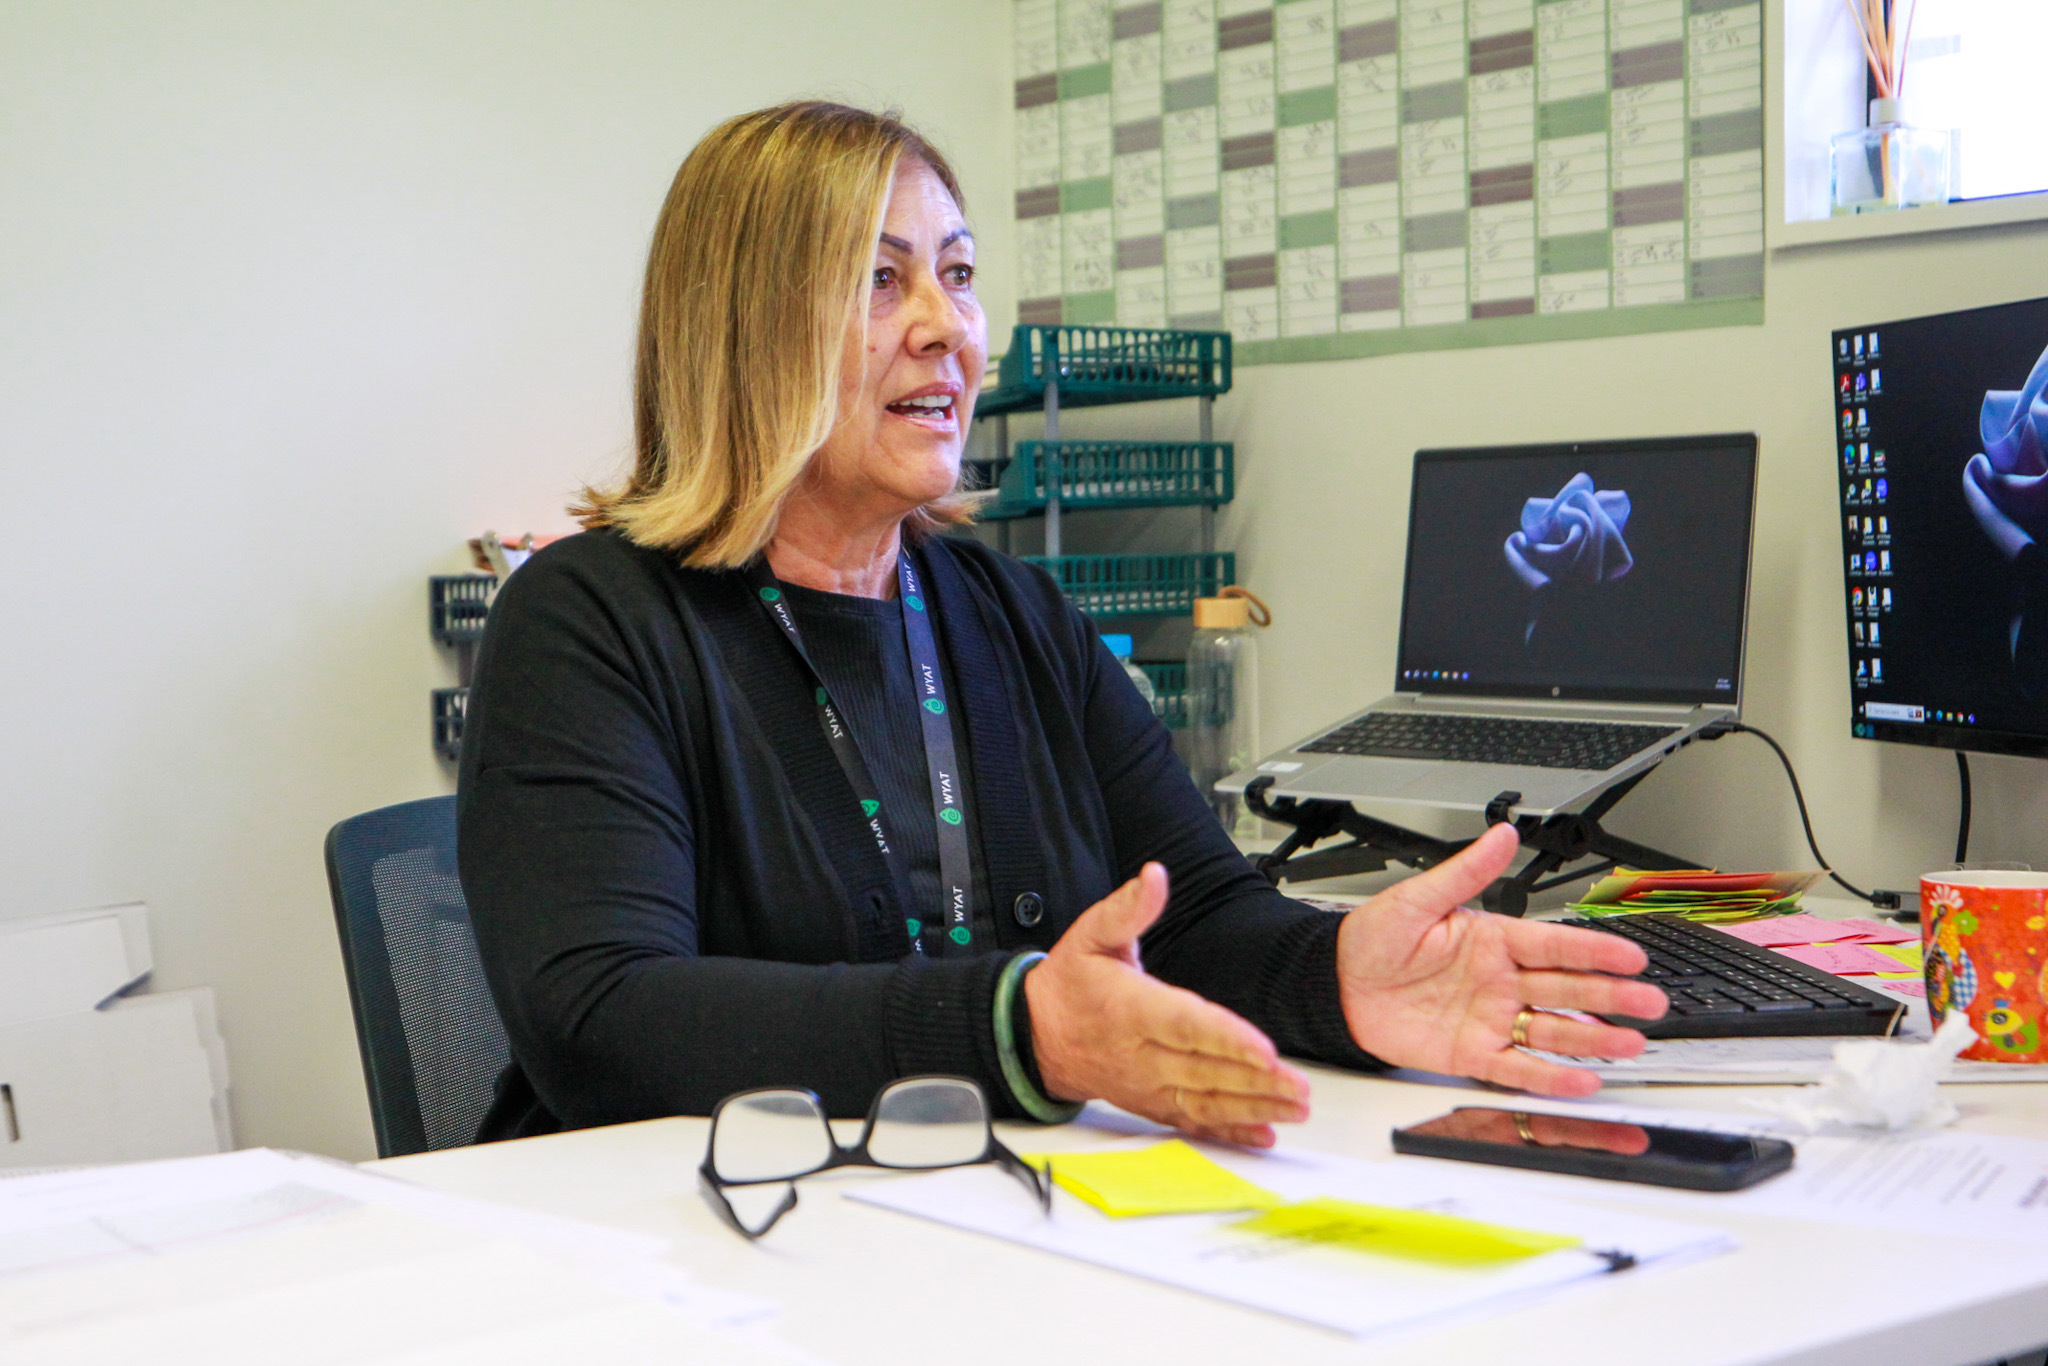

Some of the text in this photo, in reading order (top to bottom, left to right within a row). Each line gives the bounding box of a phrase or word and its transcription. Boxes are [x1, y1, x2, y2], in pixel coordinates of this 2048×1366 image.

[774, 602, 796, 633] WYAT
[921, 663, 936, 695] WYAT
[825, 704, 844, 739] WYAT
[939, 770, 954, 805] WYAT
[869, 818, 890, 854] WYAT
[952, 885, 964, 922] WYAT
